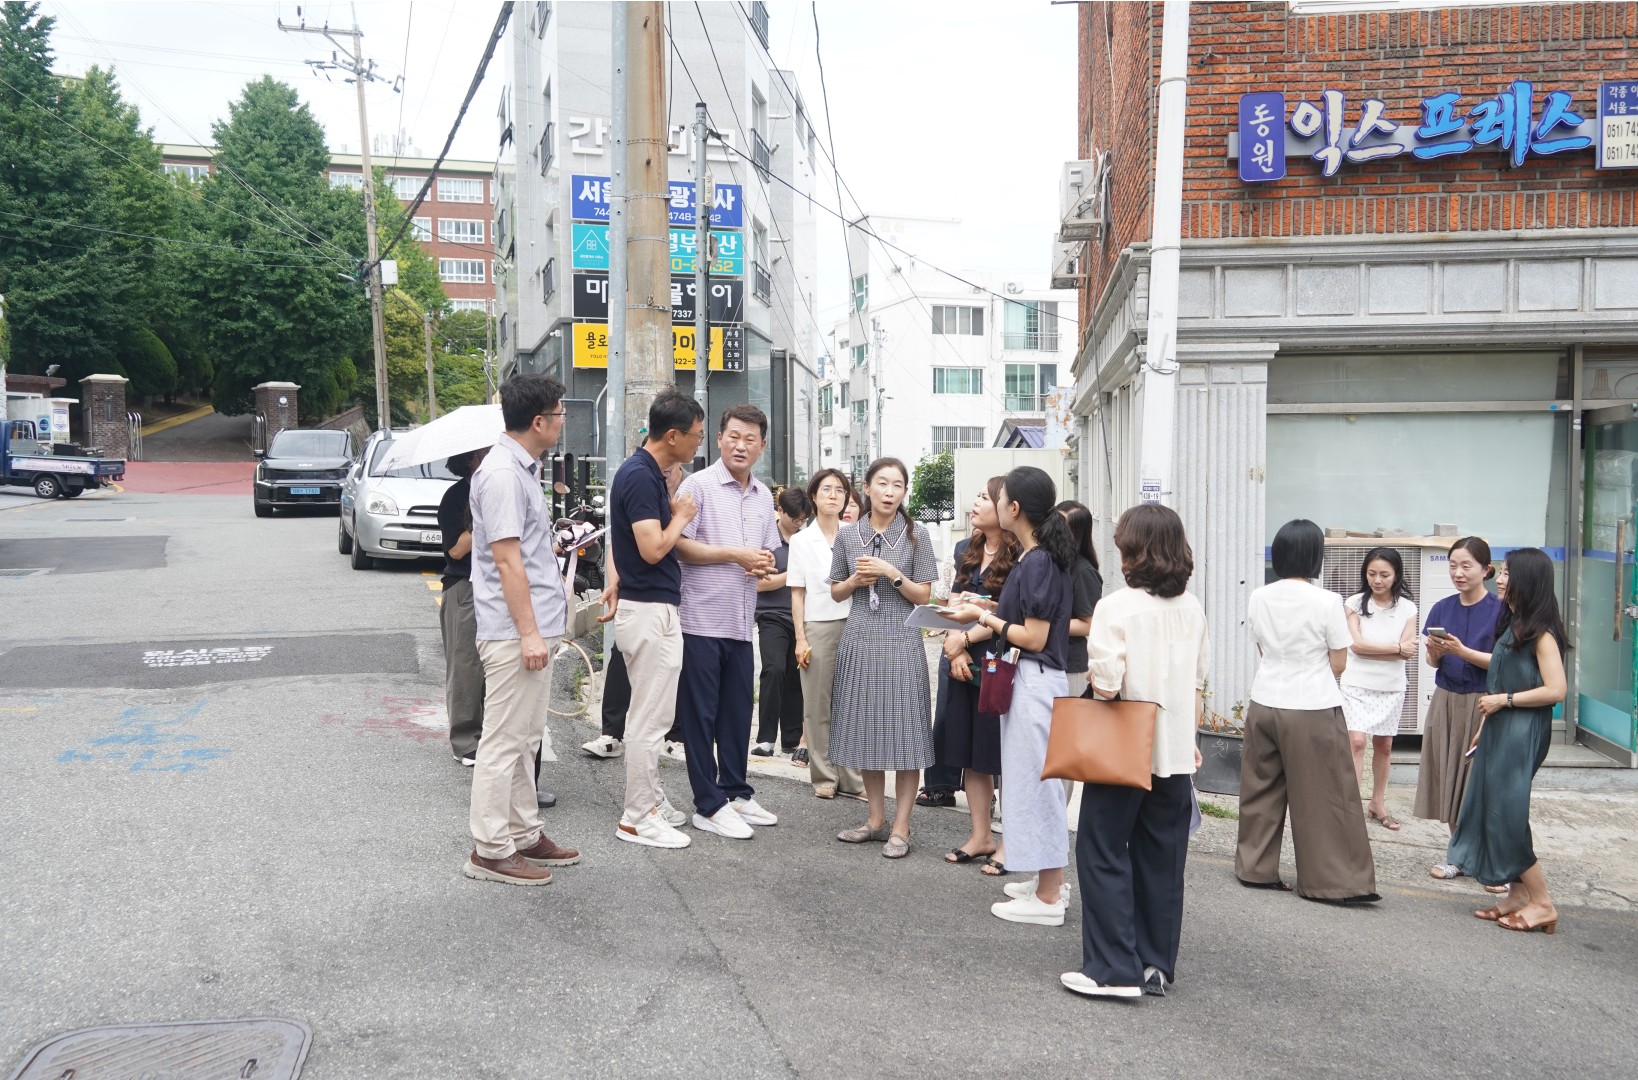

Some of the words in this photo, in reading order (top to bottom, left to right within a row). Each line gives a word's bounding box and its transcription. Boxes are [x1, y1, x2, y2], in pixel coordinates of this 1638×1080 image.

[1609, 86, 1628, 99] 각종
[1608, 101, 1628, 114] 서울
[1248, 104, 1275, 174] 동원
